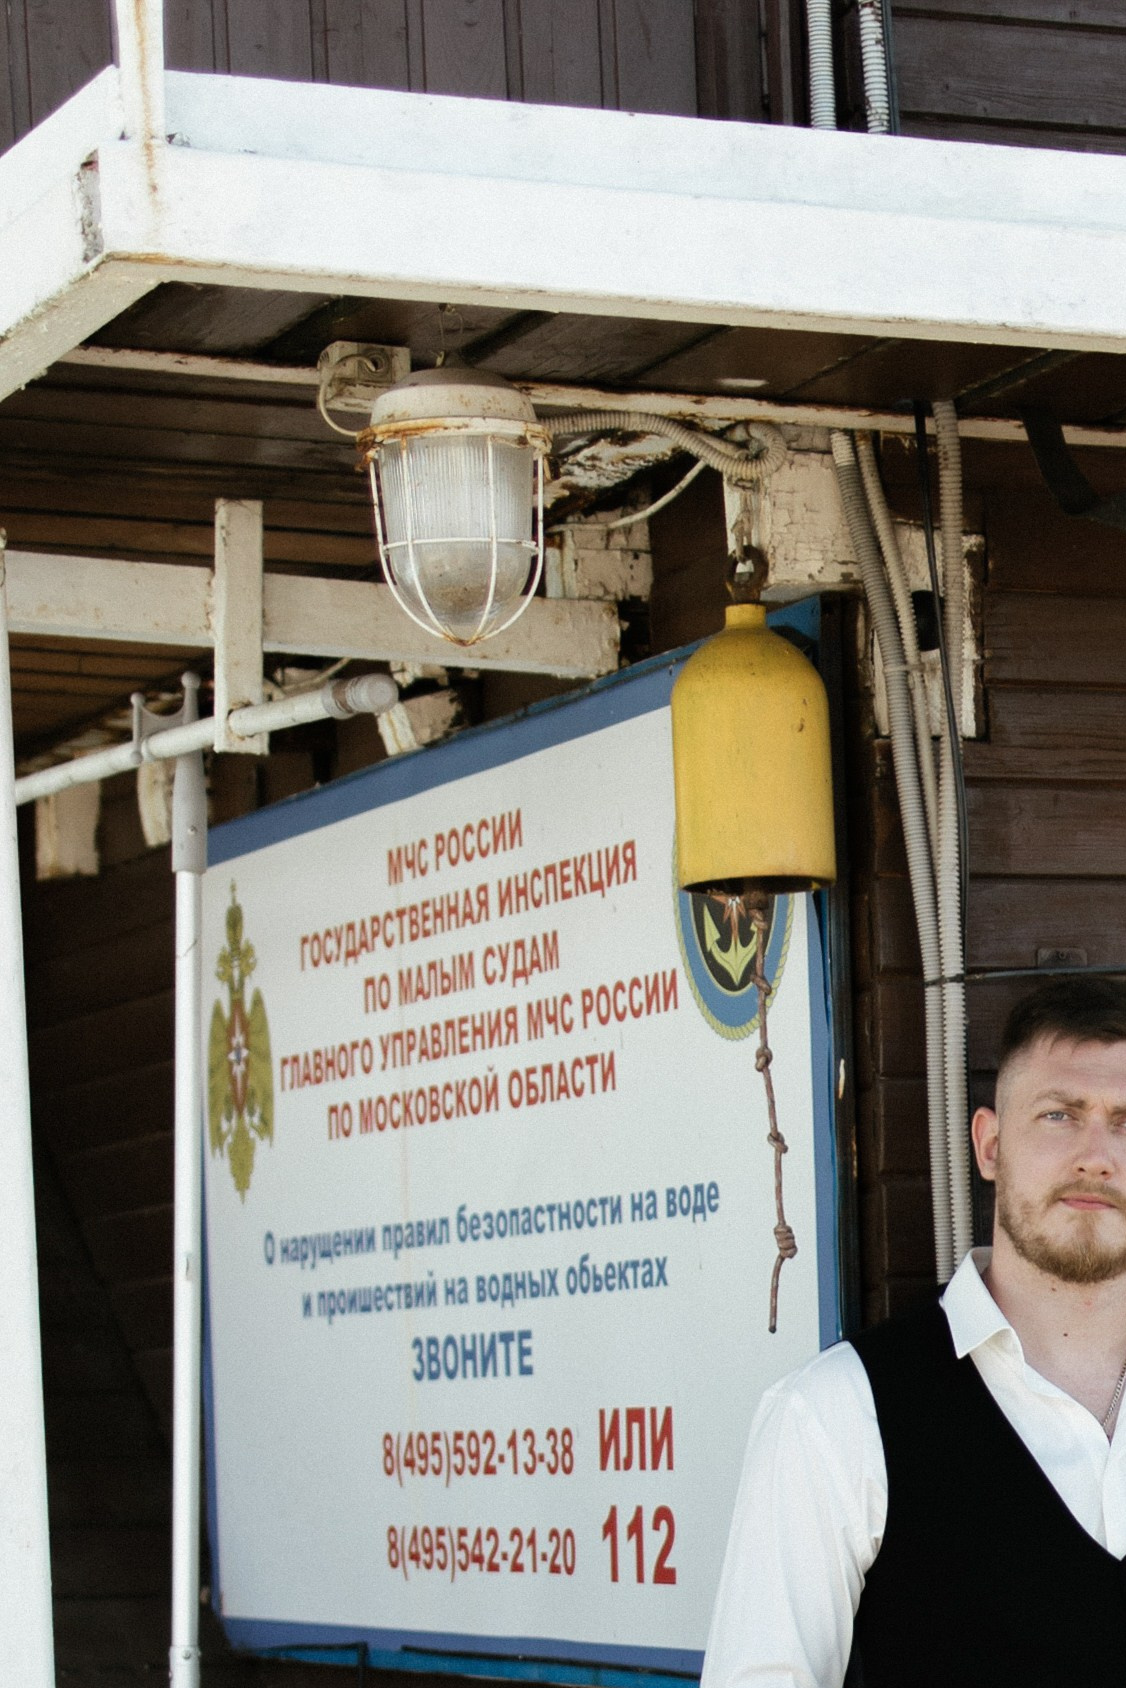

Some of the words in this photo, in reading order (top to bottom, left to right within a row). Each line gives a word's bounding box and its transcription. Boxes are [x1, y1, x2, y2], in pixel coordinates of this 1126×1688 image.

[386, 838, 429, 887] МЧС
[434, 807, 523, 872] РОССИИ
[299, 882, 490, 971] ГОСУДАРСТВЕННАЯ
[497, 839, 638, 918] ИНСПЕКЦИЯ
[363, 972, 392, 1014] ПО
[397, 950, 476, 1007] МАЛЫМ
[481, 929, 560, 986] СУДАМ
[279, 1037, 374, 1092] ГЛАВНОГО
[378, 1004, 519, 1072] УПРАВЛЕНИЯ
[526, 992, 575, 1041] МЧС
[580, 967, 679, 1030] РОССИИ
[327, 1101, 354, 1141] ПО
[358, 1066, 500, 1135] МОСКОВСКОЙ
[507, 1050, 617, 1110] ОБЛАСТИ
[263, 1231, 276, 1266] О
[381, 1216, 451, 1260] правил
[455, 1194, 623, 1244] безопастности
[629, 1189, 659, 1223] на
[665, 1180, 720, 1224] воде
[302, 1293, 313, 1318] и
[443, 1276, 469, 1306] на
[475, 1267, 560, 1309] водных
[411, 1329, 534, 1383] ЗВОНИТЕ
[382, 1426, 575, 1488] 8(495)592-13-38
[598, 1405, 674, 1472] ИЛИ
[386, 1524, 576, 1583] 8(495)542-21-20
[601, 1504, 677, 1586] 112
